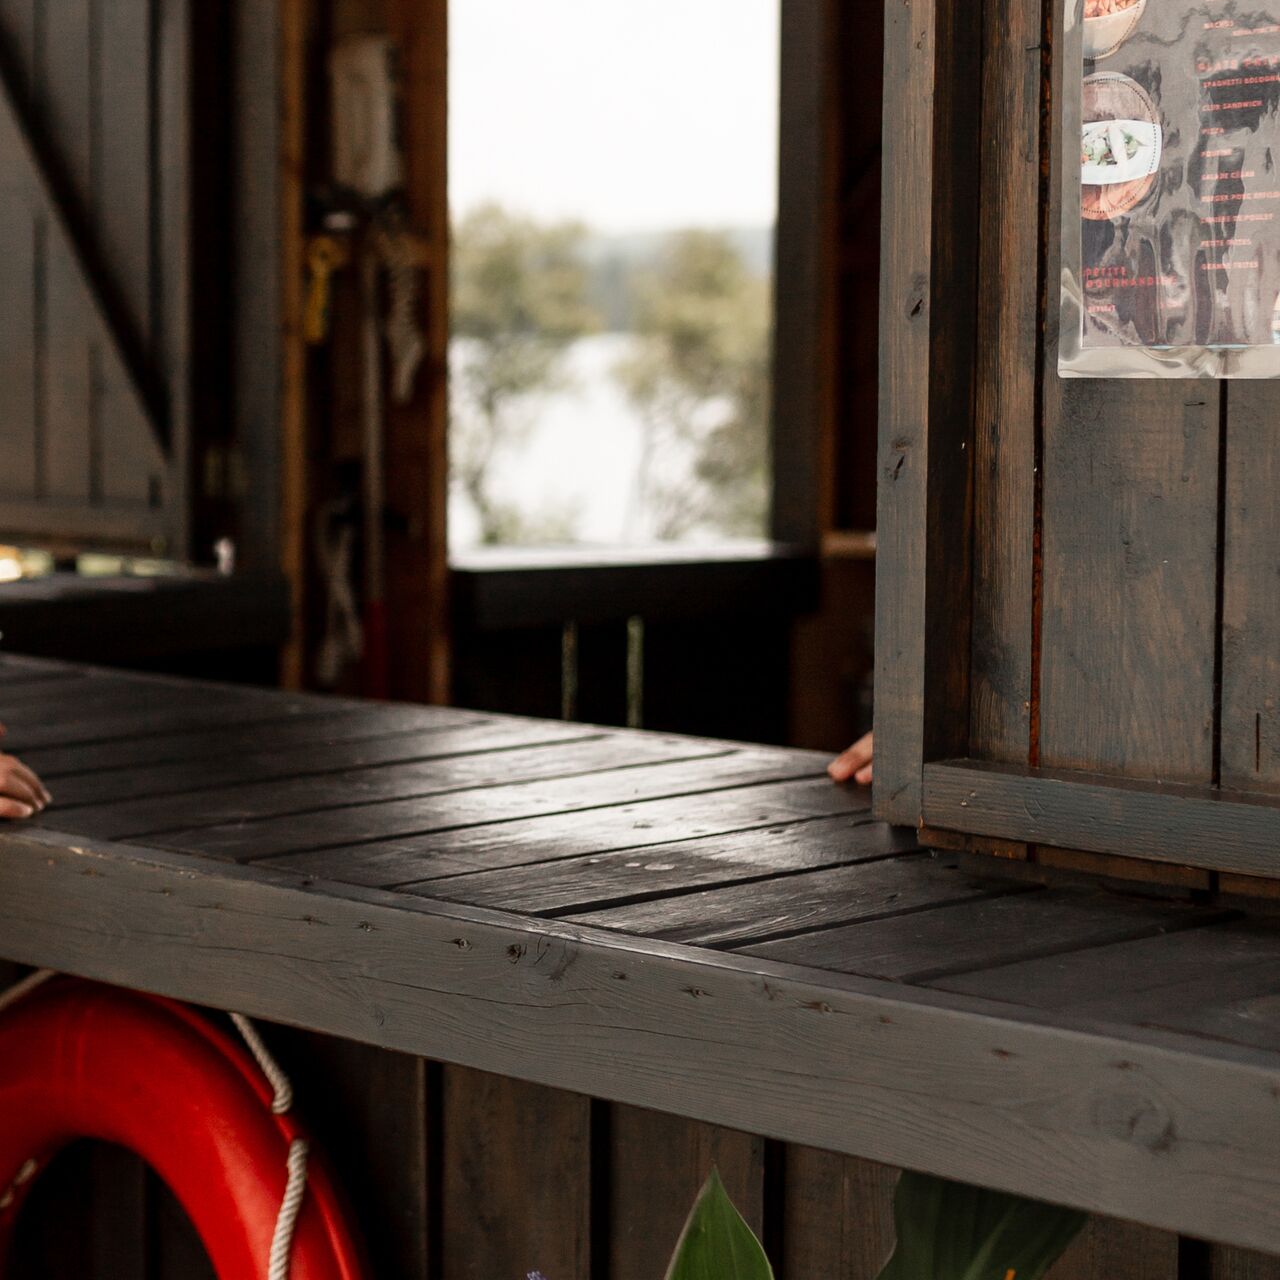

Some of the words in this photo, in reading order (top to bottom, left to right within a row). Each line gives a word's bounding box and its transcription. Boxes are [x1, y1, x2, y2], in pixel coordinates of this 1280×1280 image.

[1203, 78, 1242, 88] SPAGHETTI
[1202, 104, 1220, 112] CLUB
[1222, 100, 1263, 110] SANDWICH
